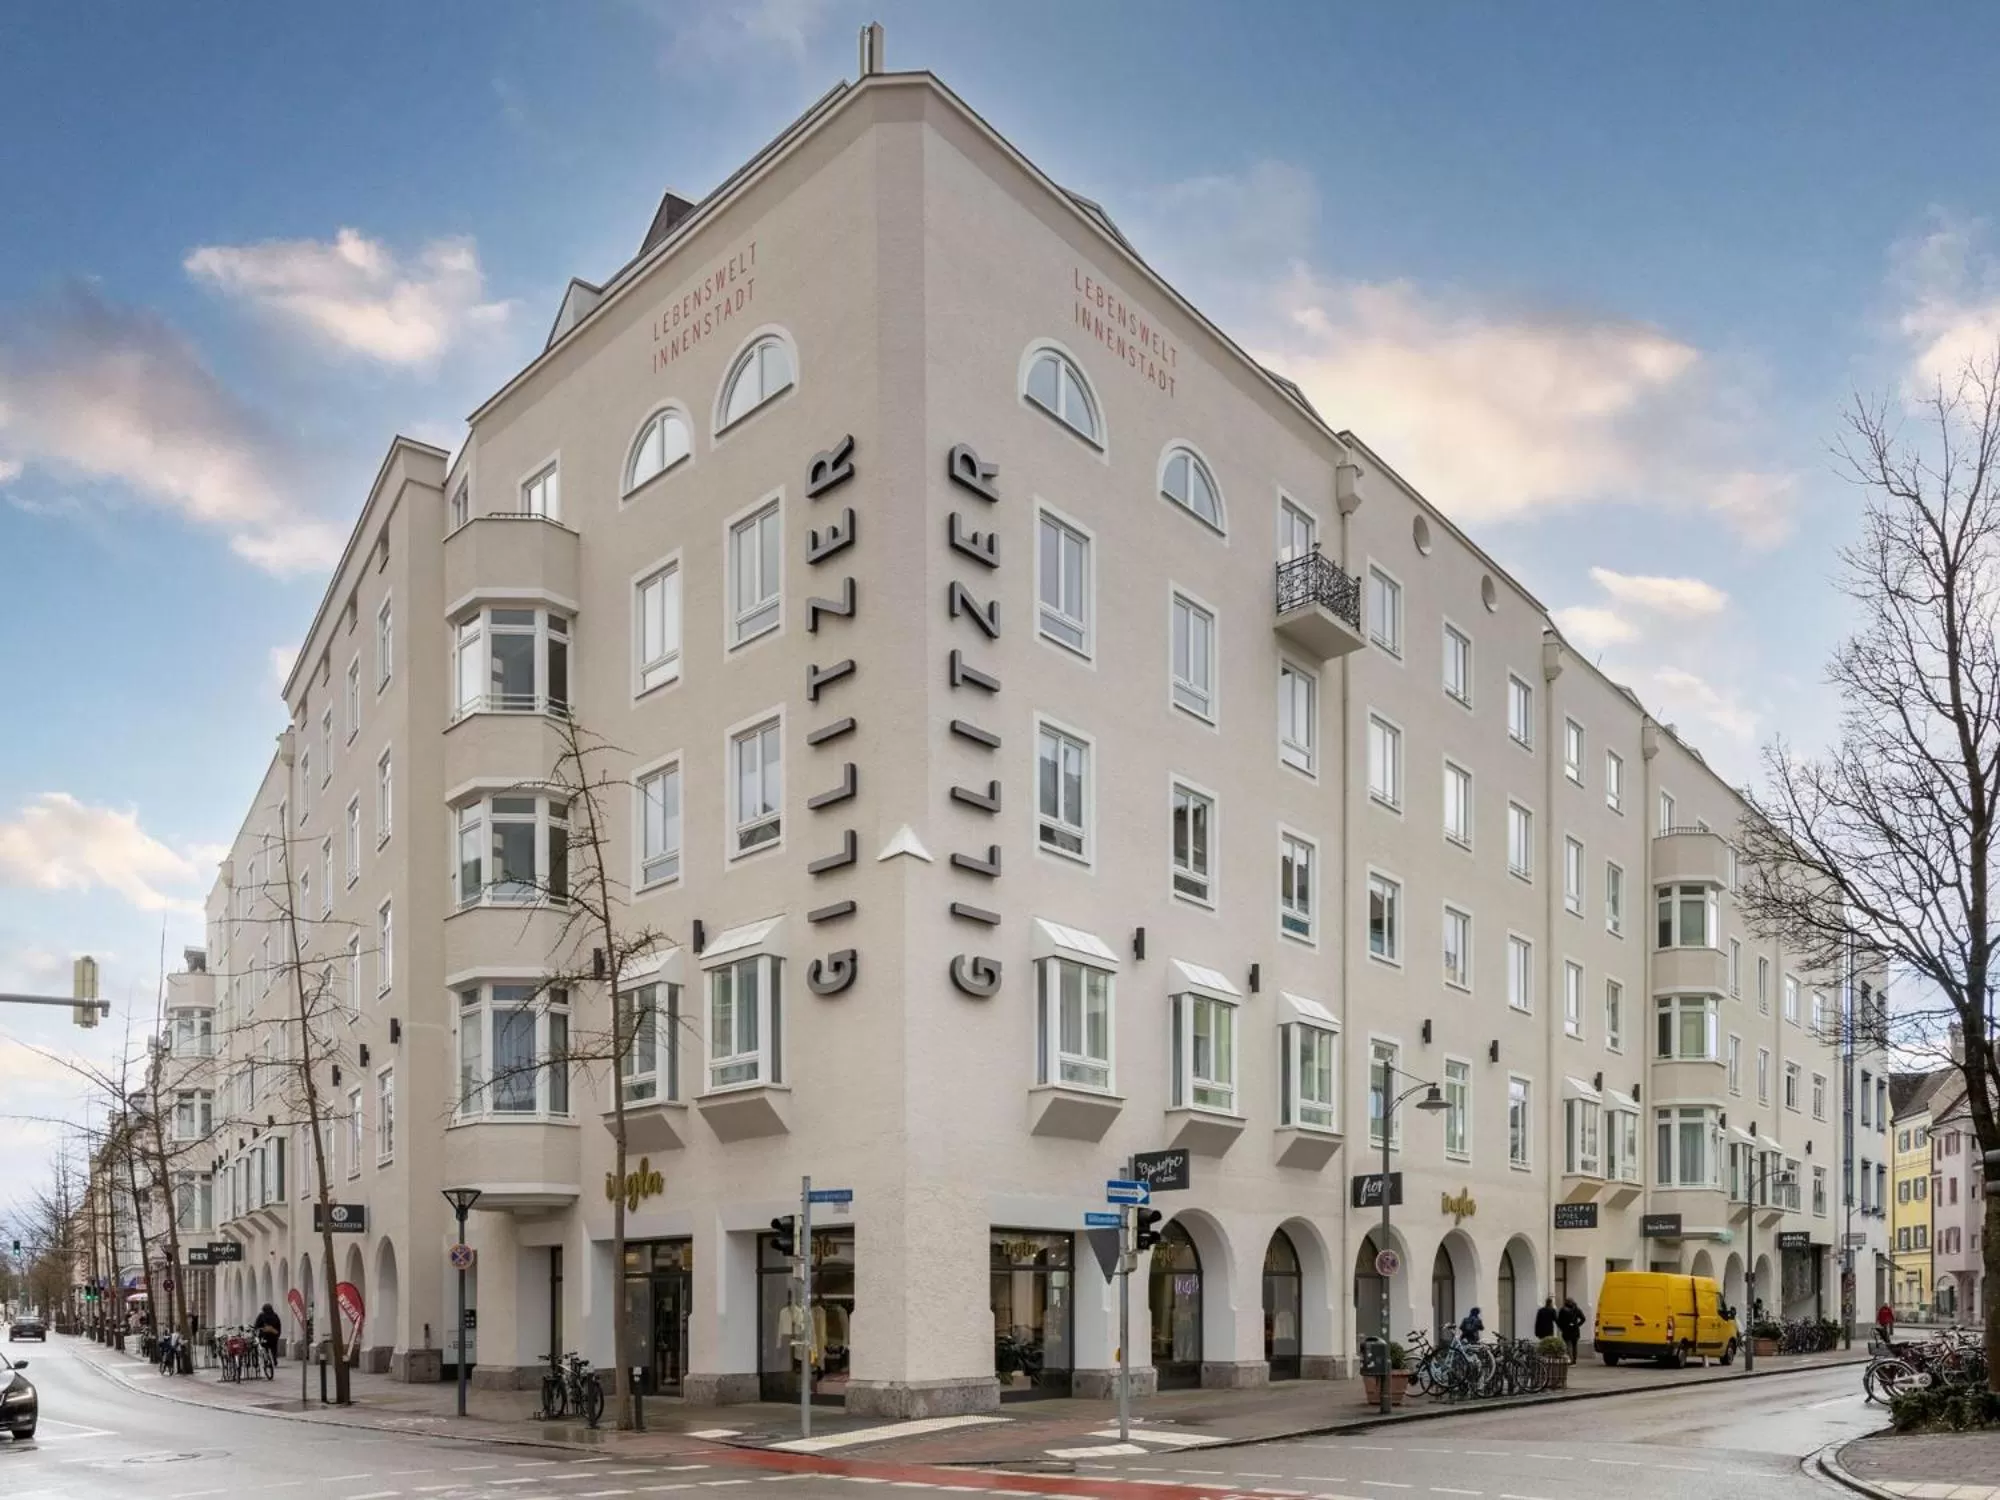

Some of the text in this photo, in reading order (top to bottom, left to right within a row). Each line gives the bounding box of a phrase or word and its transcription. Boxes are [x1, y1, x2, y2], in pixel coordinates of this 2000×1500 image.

[654, 241, 756, 342] LEBENSWELT
[654, 278, 754, 374] INNENSTADT
[1075, 267, 1178, 363] LEBENSWELT
[1075, 300, 1175, 399] INNENSTADT
[805, 433, 857, 997] GILLITZER
[949, 441, 1001, 998] GILLITZER
[1557, 1219, 1589, 1227] CENTER
